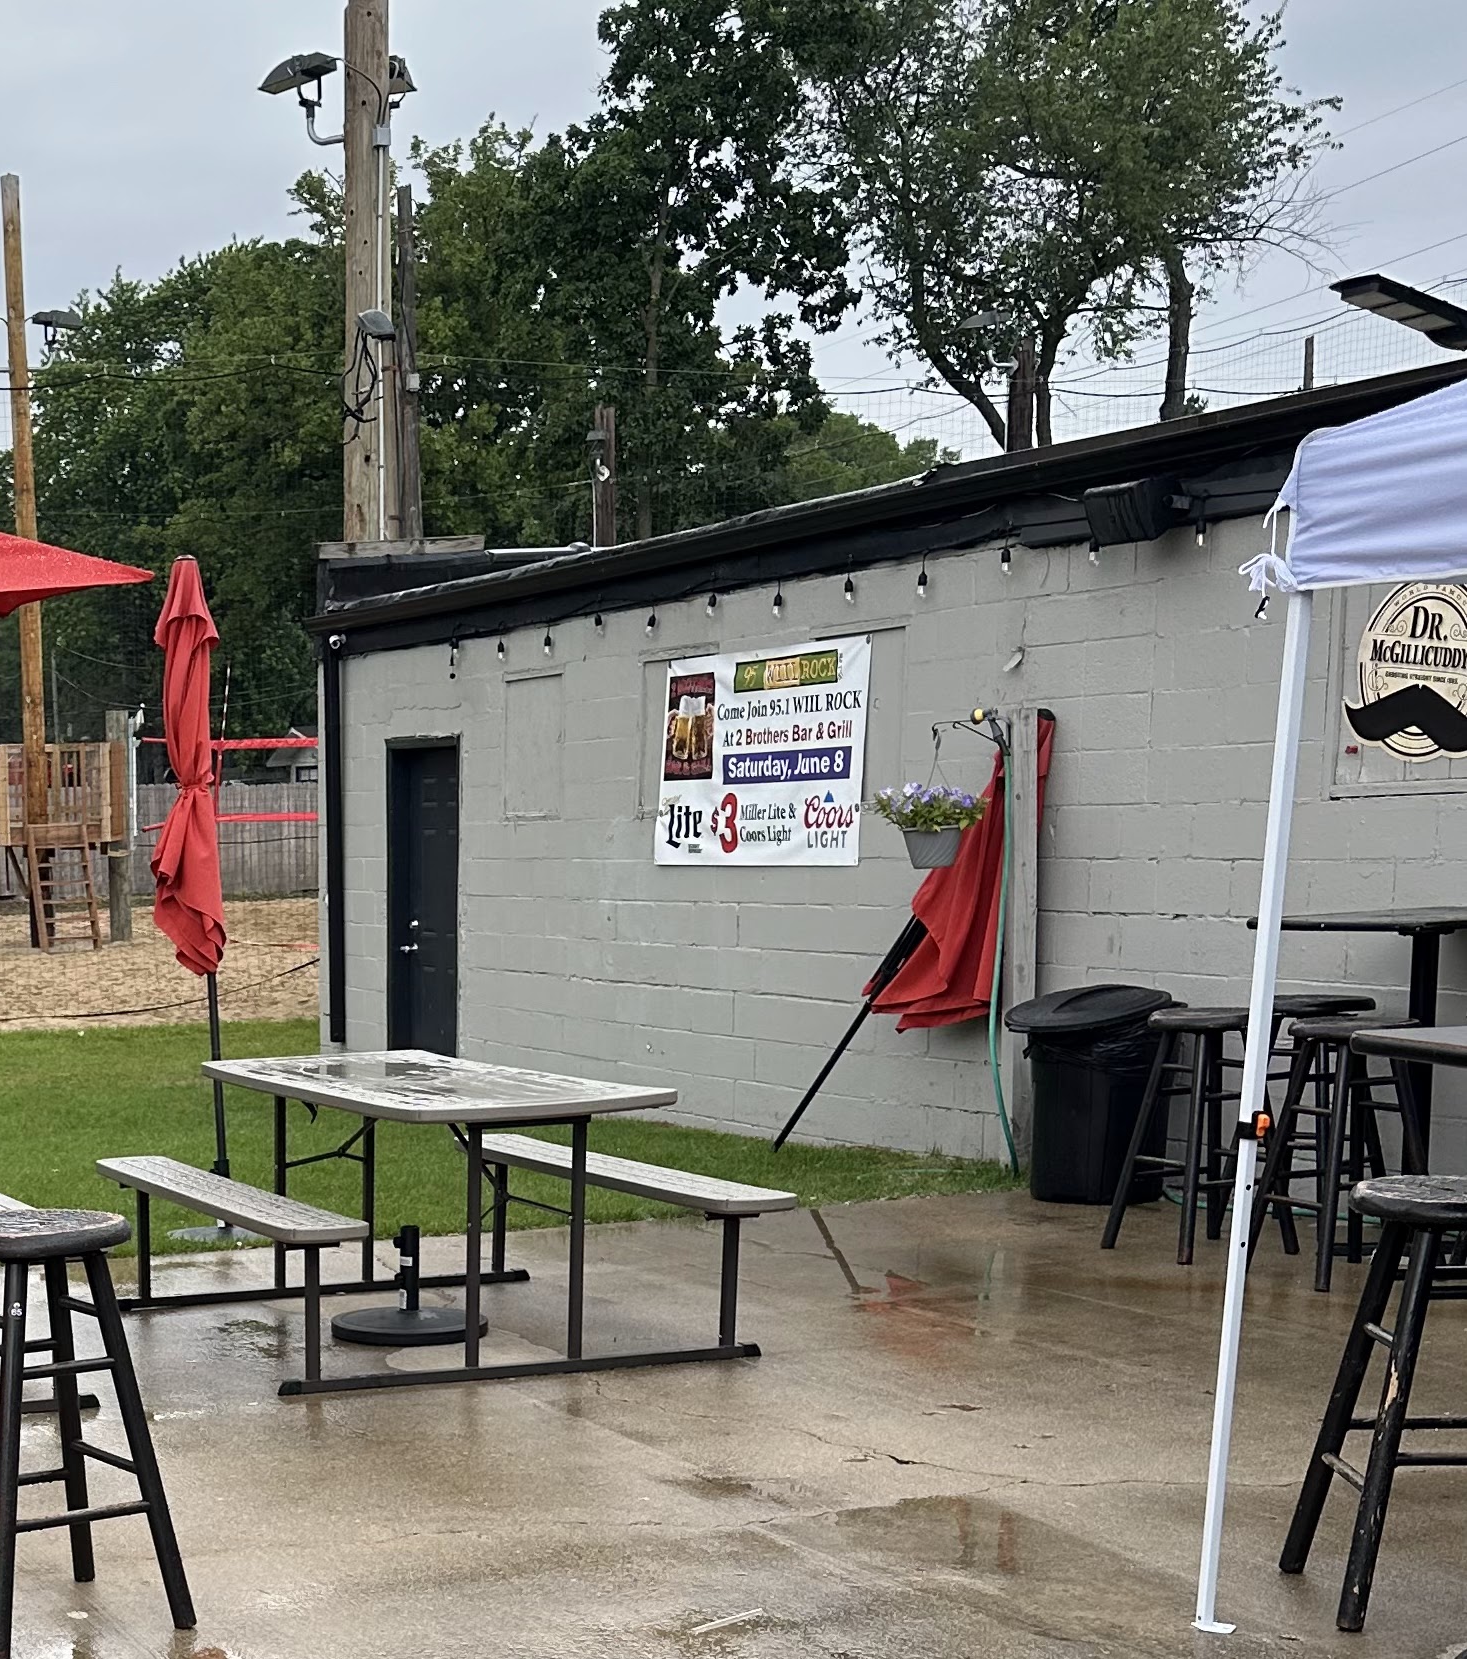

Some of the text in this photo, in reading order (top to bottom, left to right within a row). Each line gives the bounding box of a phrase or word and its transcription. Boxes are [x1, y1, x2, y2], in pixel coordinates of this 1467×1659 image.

[1436, 584, 1467, 606] FAMOU
[1409, 606, 1447, 641] DR.
[800, 657, 837, 680] ROCK
[717, 690, 862, 721] Come Join 95.1 WIIL ROCK
[722, 719, 853, 747] At 2 Brothers Bar & Grill
[728, 754, 792, 781] Saturday,
[794, 753, 831, 775] June
[833, 750, 844, 772] 8
[739, 802, 797, 821] Miller Lite &
[803, 795, 854, 829] Coors
[666, 804, 702, 849] Lite
[739, 825, 792, 846] Coors Light
[807, 830, 848, 848] LIGHT
